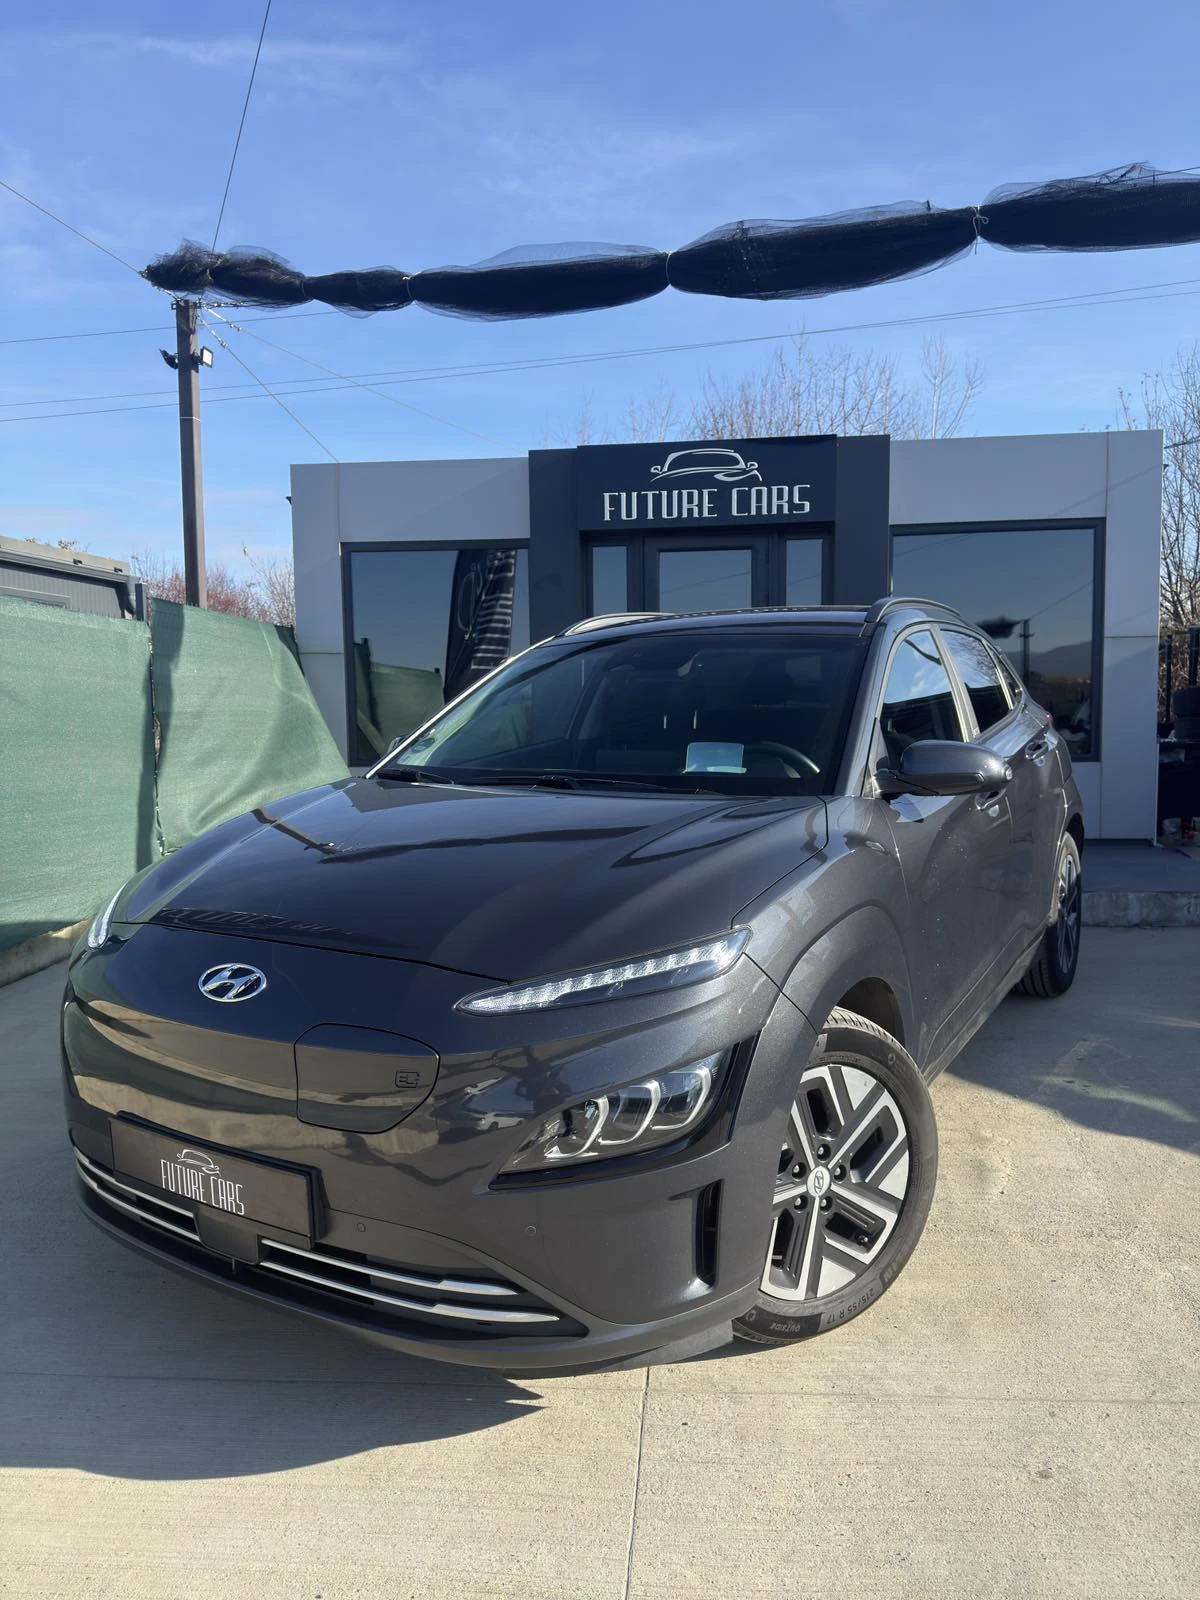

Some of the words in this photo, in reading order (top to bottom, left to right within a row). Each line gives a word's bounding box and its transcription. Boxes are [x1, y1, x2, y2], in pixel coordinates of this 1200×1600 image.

[603, 489, 717, 521] FUTURE
[731, 484, 811, 516] CARS
[160, 1160, 207, 1202] FUTURE
[210, 1176, 245, 1215] CARS
[848, 1288, 874, 1313] 215/55
[826, 1315, 836, 1324] 17
[839, 1311, 846, 1319] R
